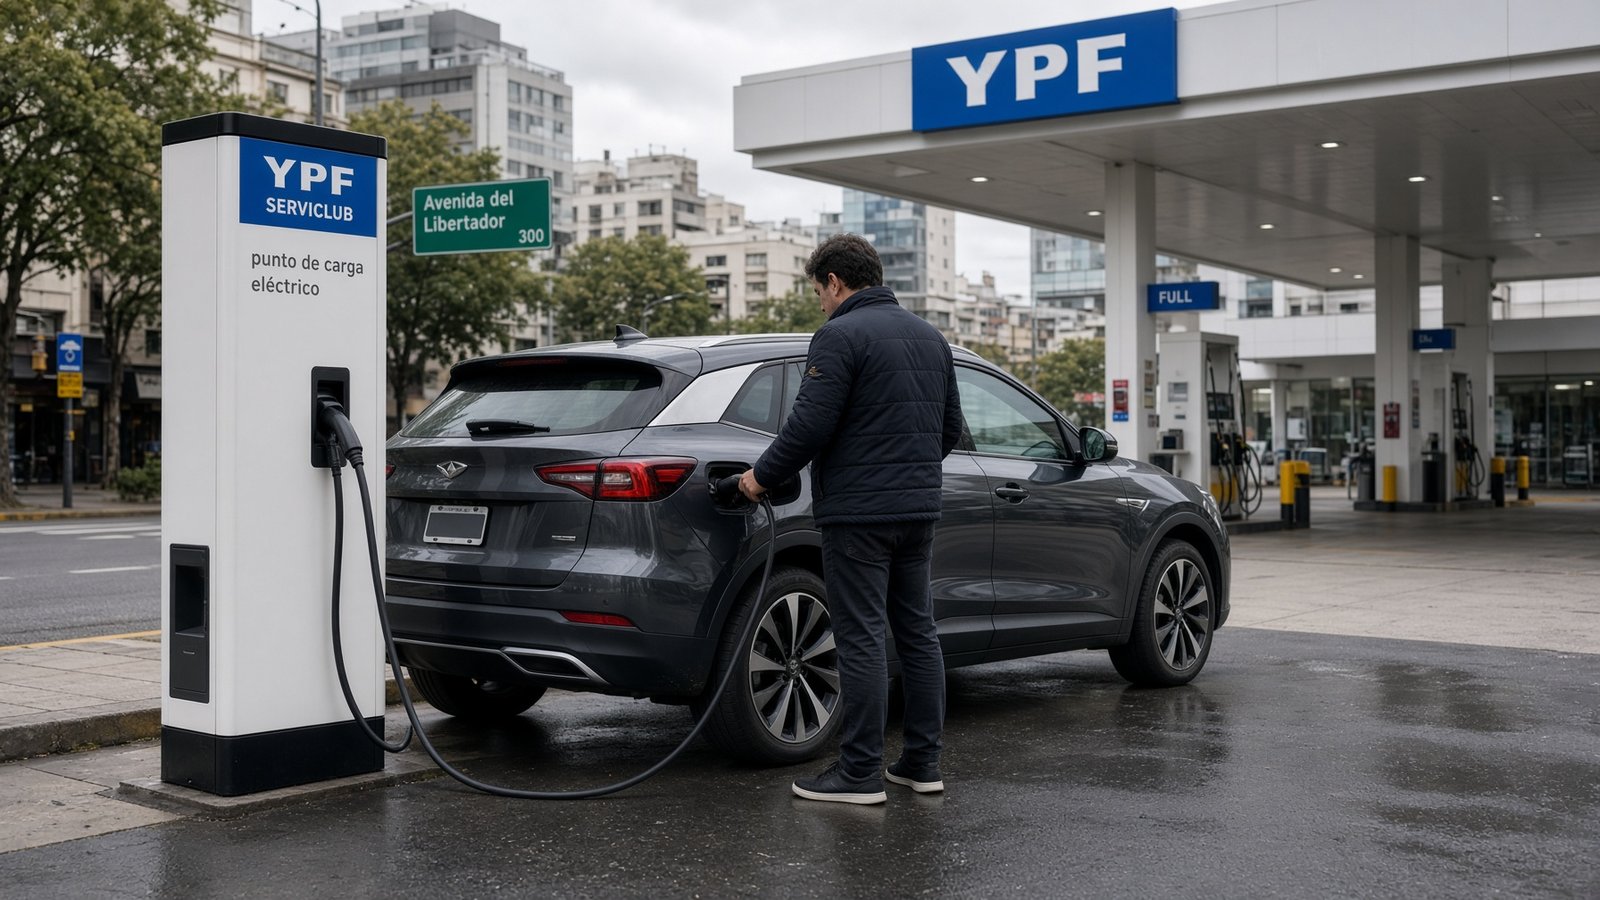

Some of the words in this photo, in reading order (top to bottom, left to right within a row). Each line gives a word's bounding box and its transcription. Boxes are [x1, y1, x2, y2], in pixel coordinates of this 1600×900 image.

[946, 32, 1126, 107] YPF
[263, 156, 354, 195] YPF
[266, 196, 353, 222] SERVICLUB
[424, 192, 484, 210] Avenida
[489, 190, 514, 206] del
[424, 213, 506, 232] Libertador
[518, 228, 544, 244] 300
[251, 252, 297, 269] punto
[301, 254, 320, 271] de
[324, 259, 364, 278] carga
[251, 276, 320, 296] eléctrico
[1158, 290, 1193, 304] FULL
